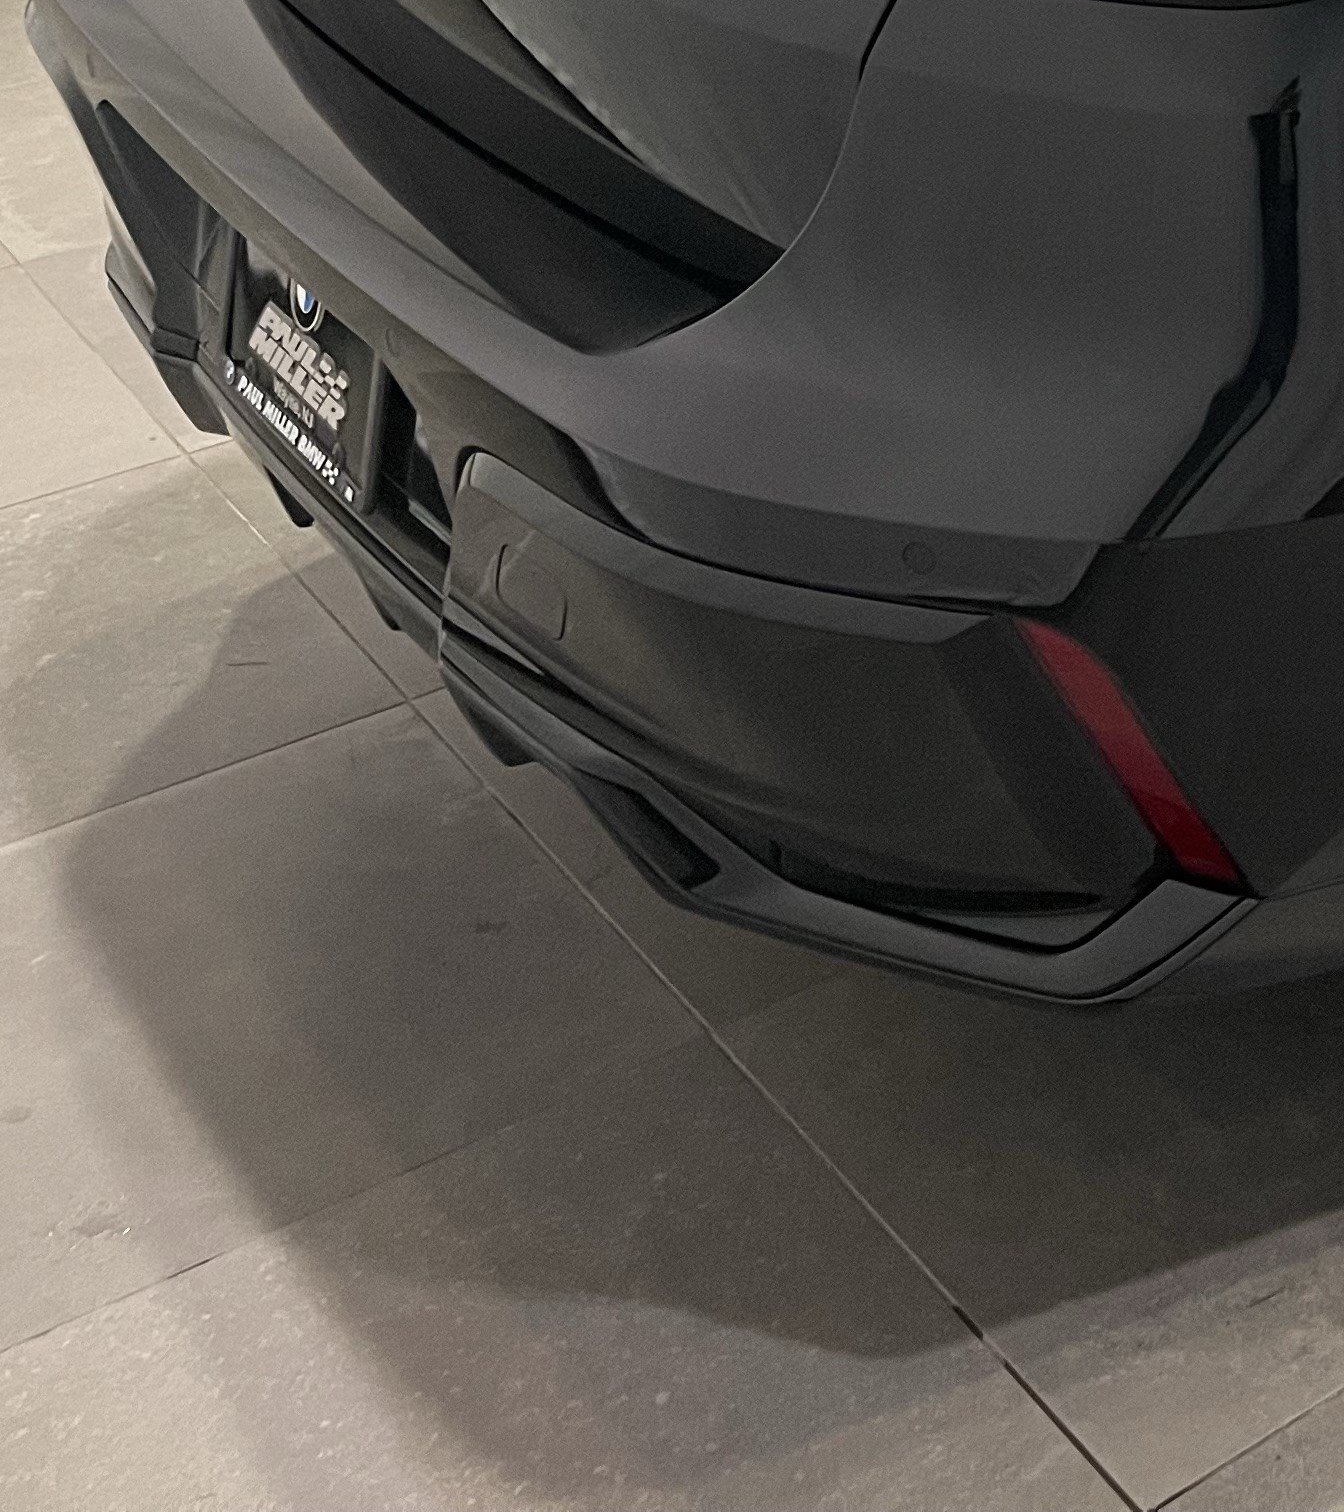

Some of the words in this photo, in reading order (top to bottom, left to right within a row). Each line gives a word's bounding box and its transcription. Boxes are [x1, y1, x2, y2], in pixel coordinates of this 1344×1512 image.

[248, 326, 345, 430] MILLER
[259, 306, 318, 376] PAUL
[237, 375, 264, 411] PAUL
[262, 400, 299, 445] MILLER
[297, 434, 326, 470] BMW
